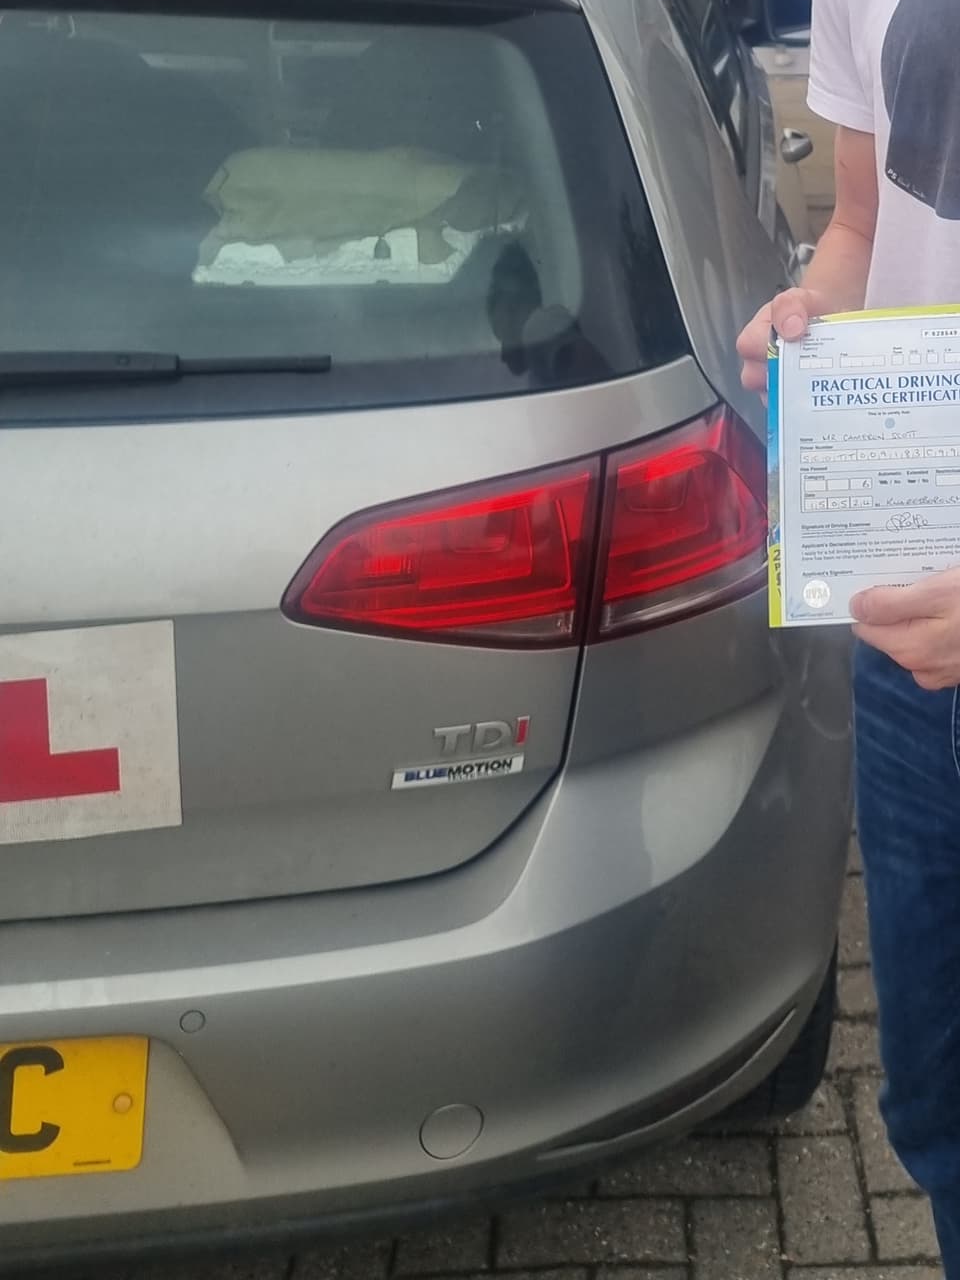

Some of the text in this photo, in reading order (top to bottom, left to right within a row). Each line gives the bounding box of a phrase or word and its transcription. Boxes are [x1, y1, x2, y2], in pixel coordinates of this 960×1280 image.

[811, 377, 892, 392] PRACTICAL
[811, 394, 843, 407] TEST
[847, 392, 878, 406] PASS
[0, 678, 120, 803] L
[432, 715, 530, 754] TDI
[404, 758, 513, 782] BLUEMOTION
[0, 1046, 64, 1154] C
